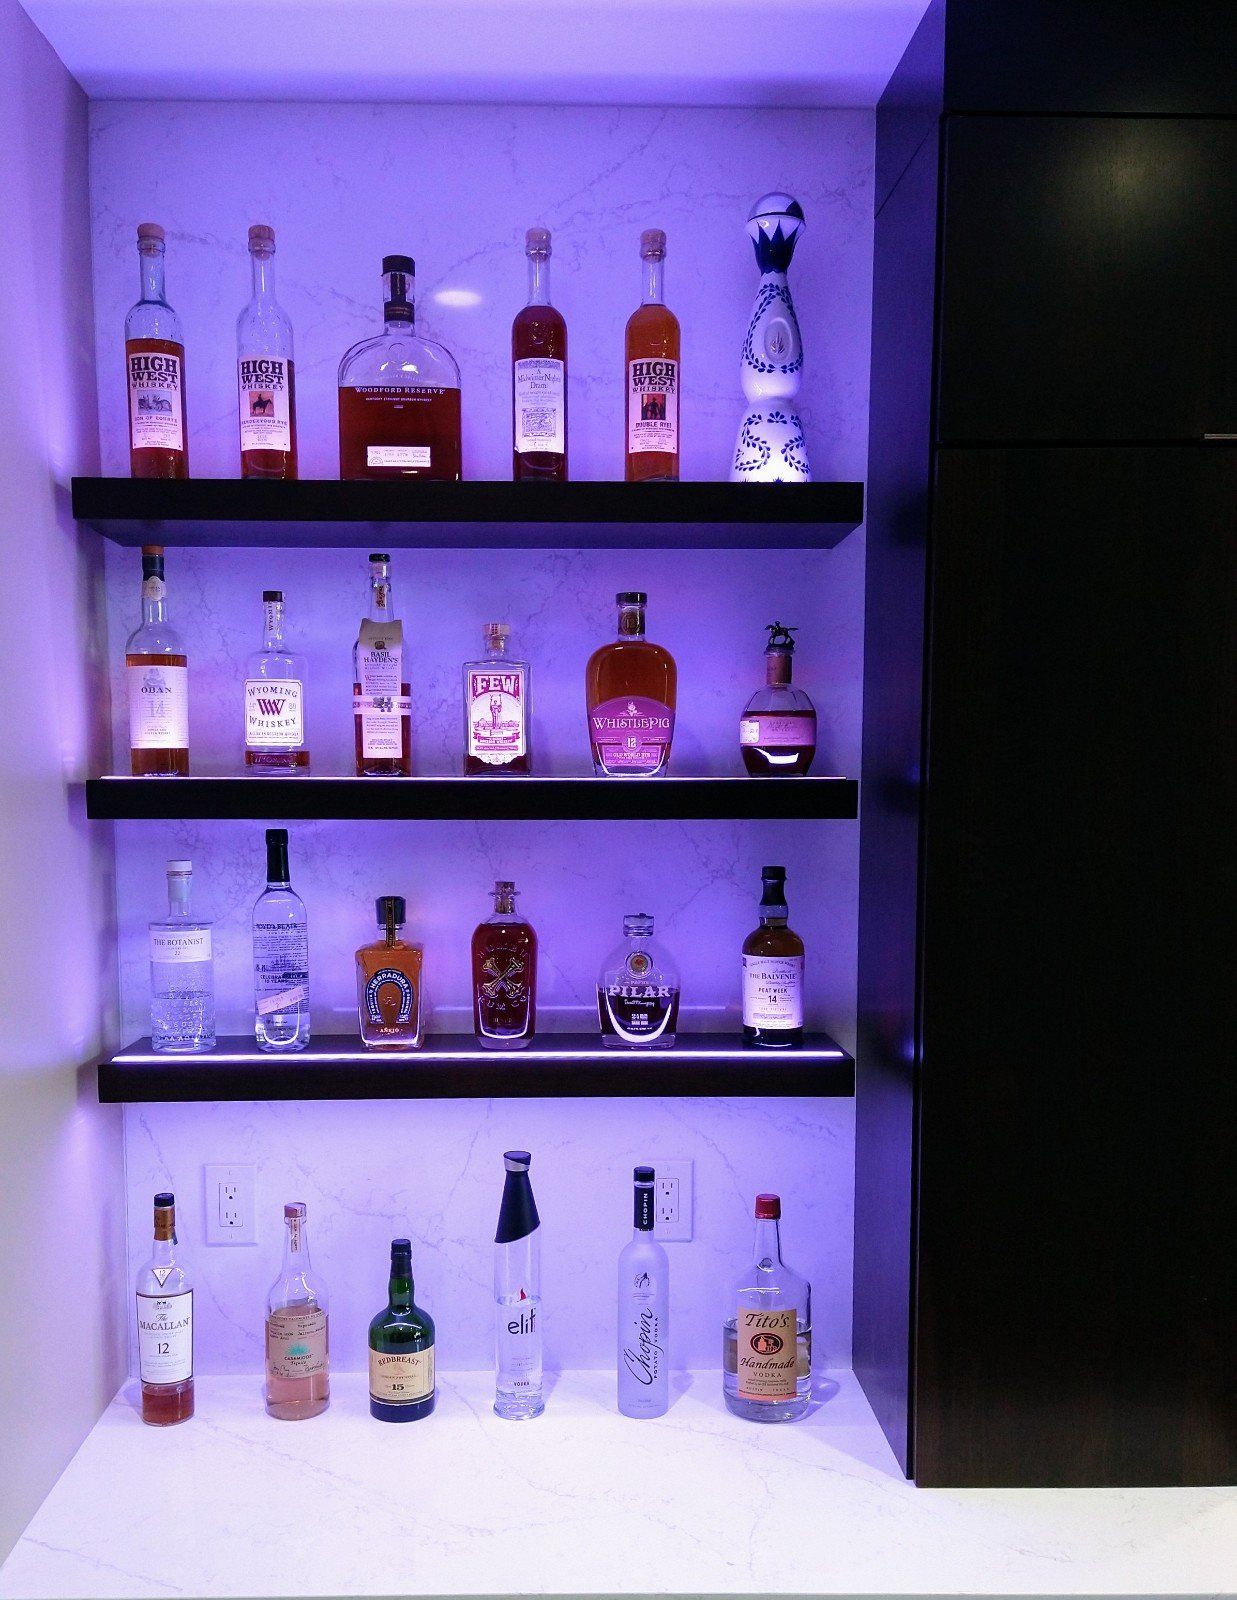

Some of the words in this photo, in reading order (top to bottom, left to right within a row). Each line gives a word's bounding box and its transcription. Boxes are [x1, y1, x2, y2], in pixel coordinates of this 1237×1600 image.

[130, 356, 178, 374] HIGH
[240, 360, 283, 375] HIGH
[632, 362, 676, 377] HIGH
[131, 371, 178, 384] WEST
[241, 373, 284, 385] WEST
[632, 375, 676, 387] WEST
[131, 381, 178, 391] WHISKEY
[241, 383, 284, 391] WHISKEY
[404, 387, 445, 395] RESERVE
[632, 385, 676, 395] WHISKEY
[363, 656, 399, 664] HAYDEN'S
[475, 675, 517, 693] FEW
[247, 686, 298, 698] WYOMING
[249, 715, 297, 729] WHISKEY
[153, 938, 166, 946] THE
[167, 938, 204, 946] BOTANIST
[369, 972, 409, 989] HERRADURA
[761, 972, 797, 980] BALVENIE
[608, 984, 672, 998] PILAR
[768, 995, 778, 1004] 14
[641, 1192, 649, 1226] CHOPIN
[158, 1269, 167, 1277] 12
[139, 1316, 190, 1331] MACALLAN
[155, 1313, 169, 1322] The
[507, 1308, 536, 1335] elit
[745, 1312, 790, 1329] Tito's
[157, 1342, 170, 1355] 12
[623, 1307, 665, 1385] Chopin
[377, 1355, 421, 1367] REDBREAST
[739, 1356, 795, 1370] Handmade
[391, 1383, 405, 1391] 15
